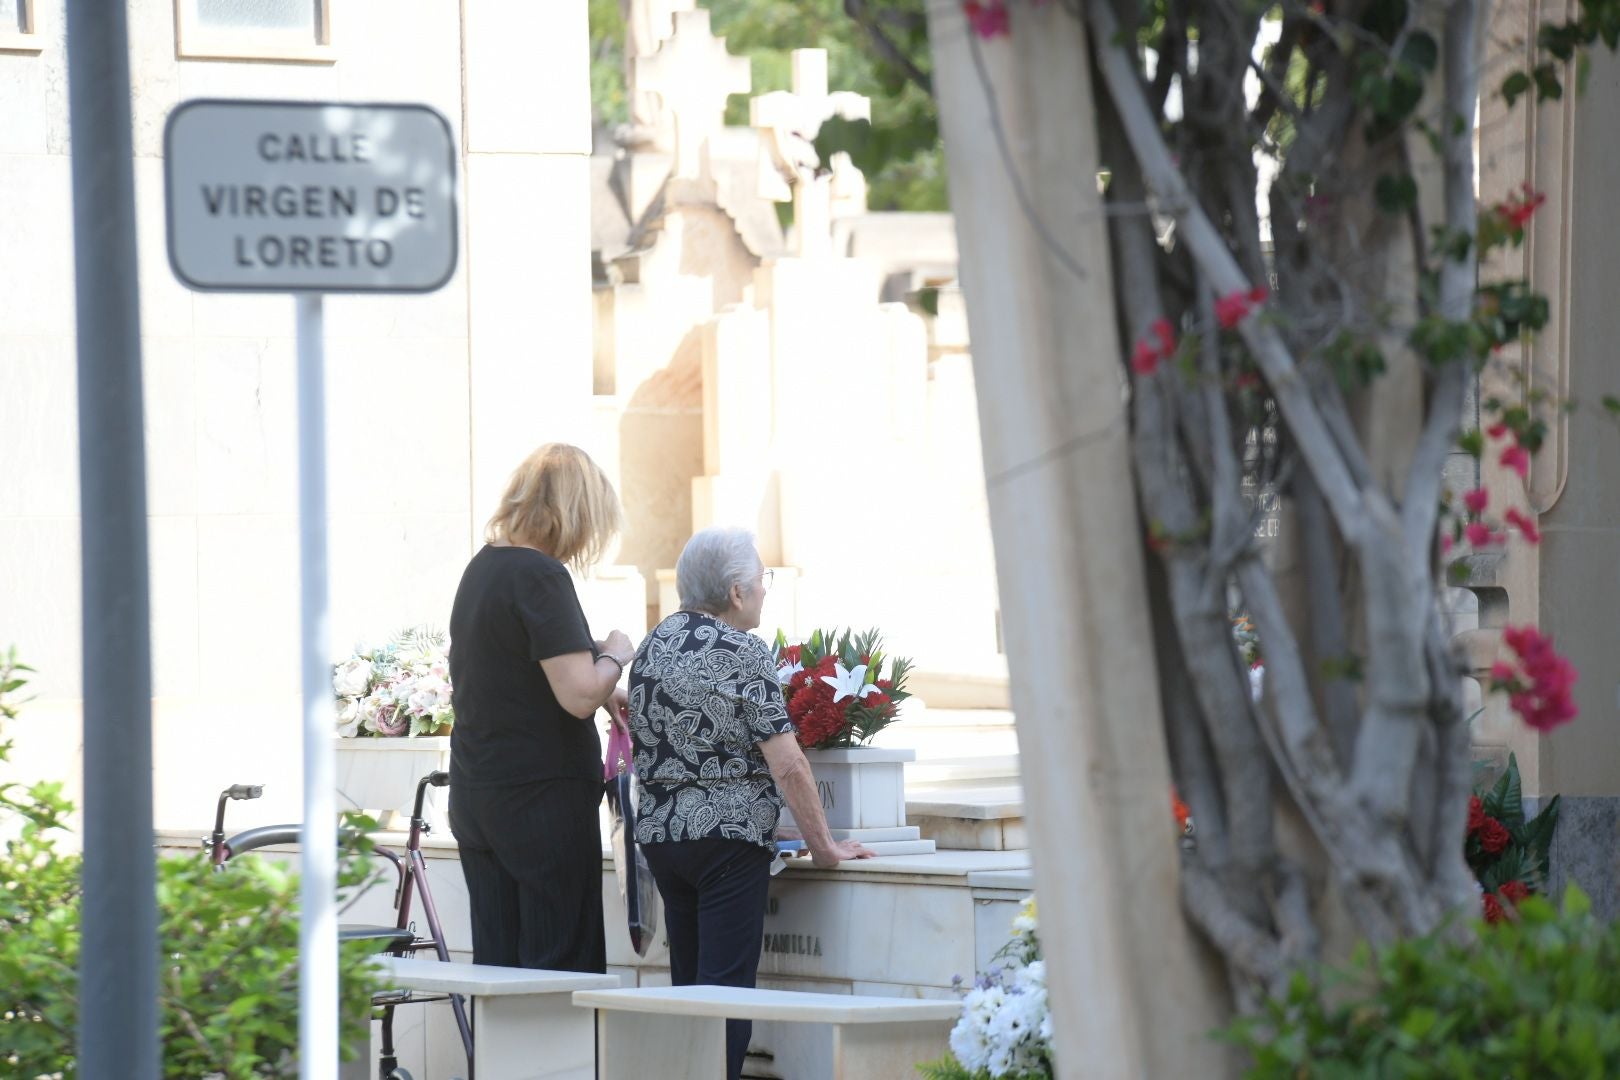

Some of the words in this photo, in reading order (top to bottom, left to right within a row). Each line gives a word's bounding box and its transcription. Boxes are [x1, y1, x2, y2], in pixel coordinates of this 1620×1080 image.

[257, 133, 371, 163] CALLE
[202, 185, 357, 217] VIRGEN
[374, 186, 426, 218] DE
[233, 234, 394, 268] LORETO
[763, 933, 823, 956] FAMILIA
